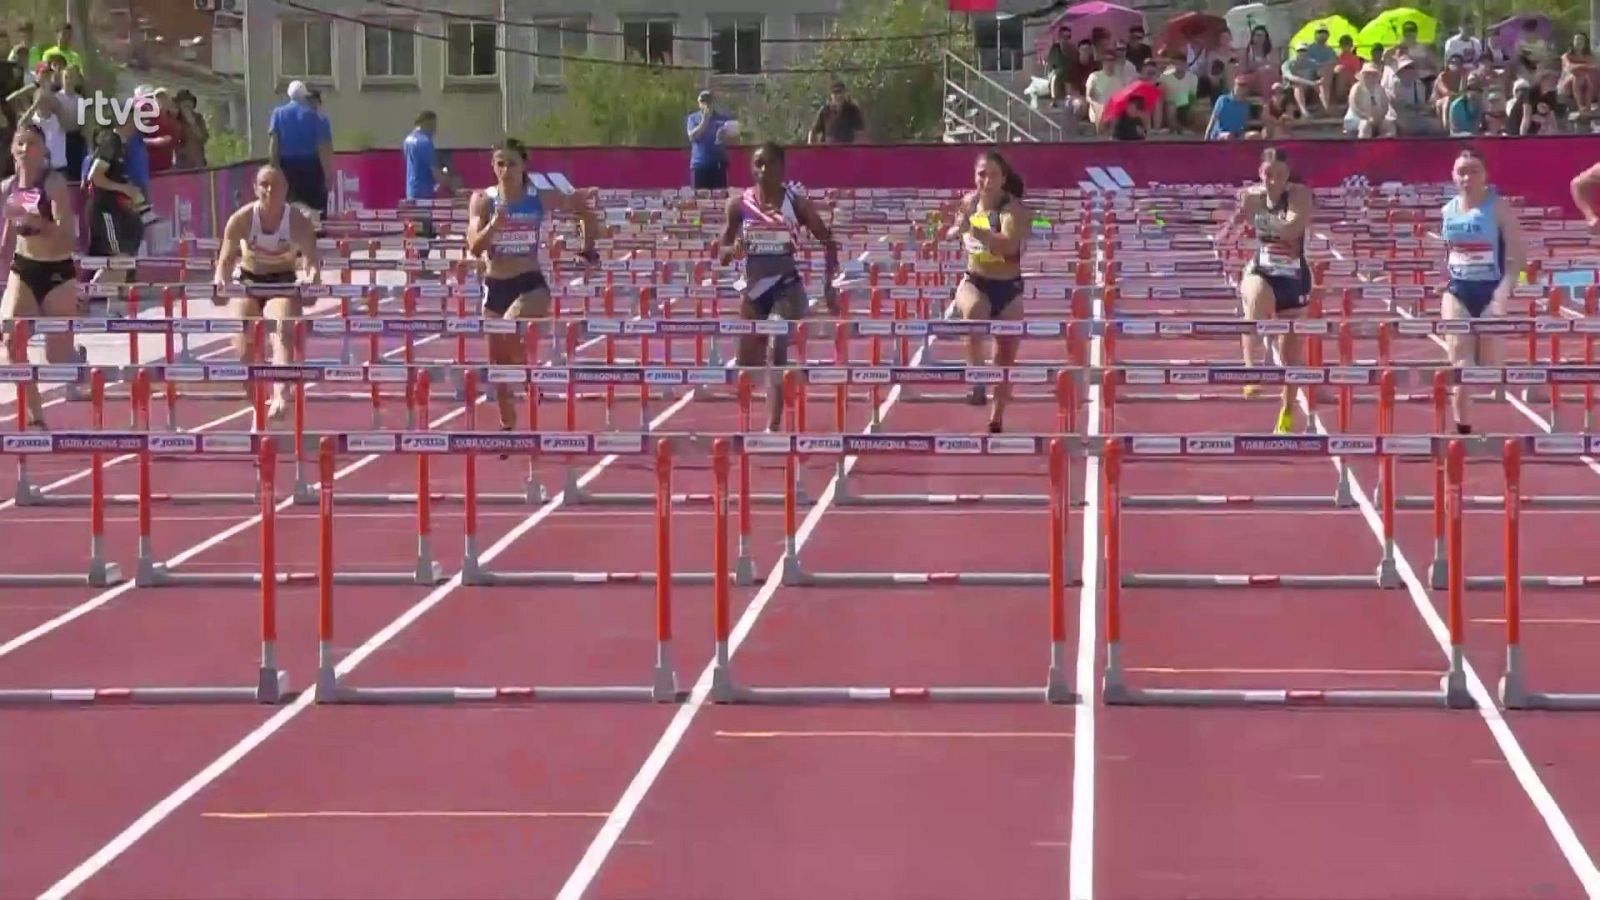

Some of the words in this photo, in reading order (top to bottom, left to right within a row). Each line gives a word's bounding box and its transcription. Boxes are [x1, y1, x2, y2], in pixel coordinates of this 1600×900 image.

[57, 438, 117, 449] TARRAGONA
[452, 438, 513, 449] TARRAGONA
[850, 438, 907, 450] TARRAGONA
[1241, 440, 1298, 450] TARRAGONA
